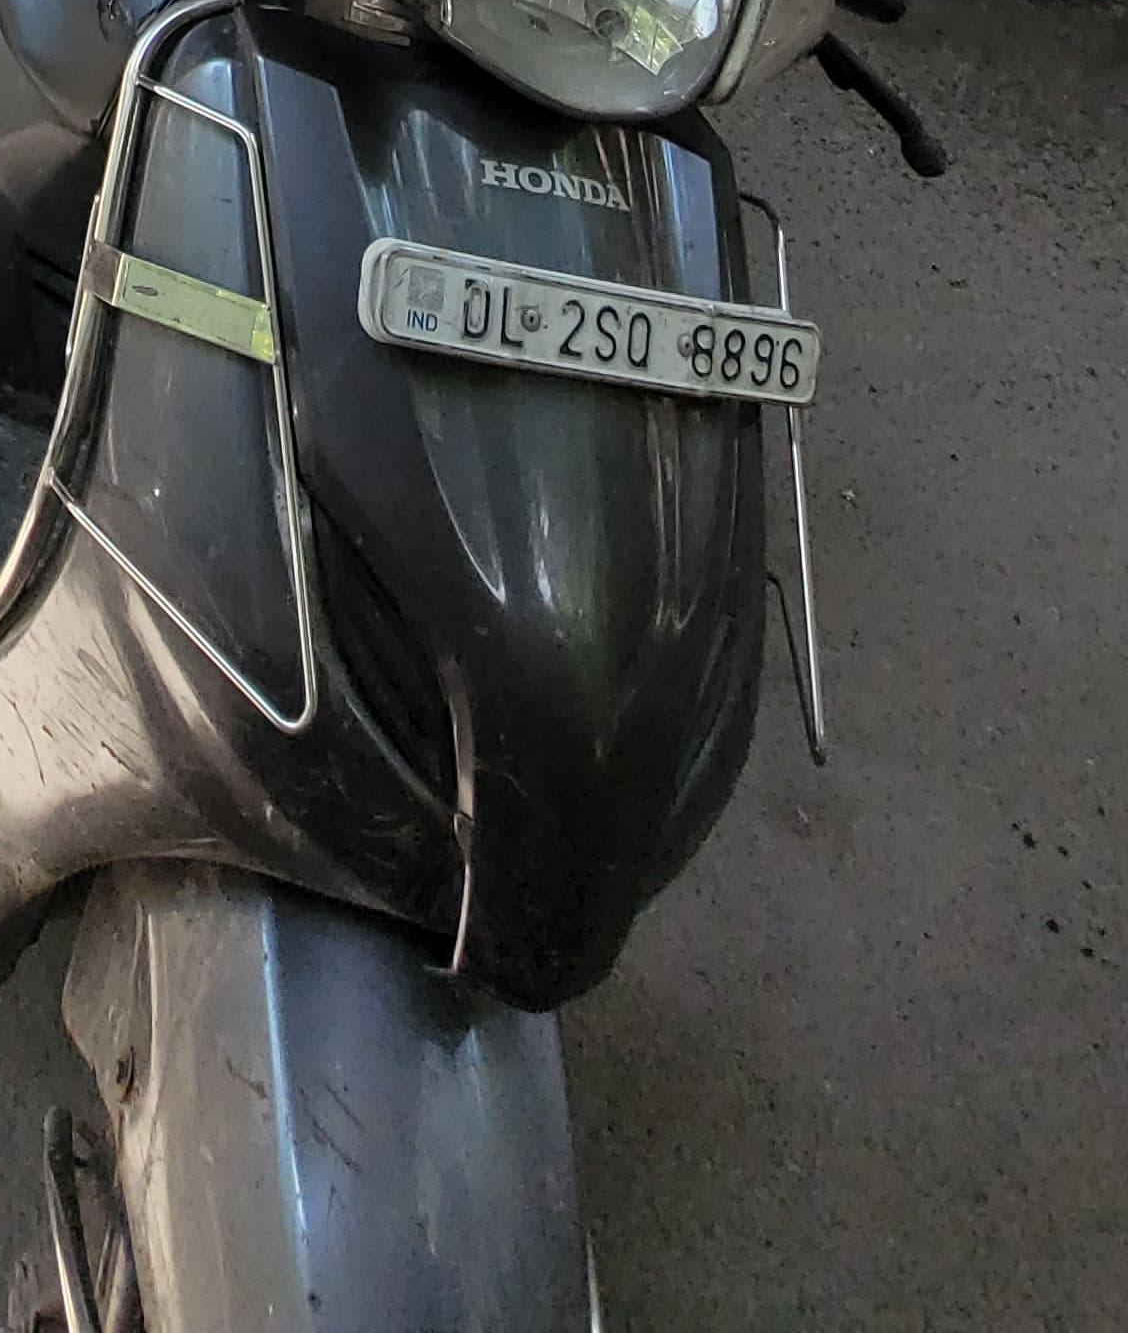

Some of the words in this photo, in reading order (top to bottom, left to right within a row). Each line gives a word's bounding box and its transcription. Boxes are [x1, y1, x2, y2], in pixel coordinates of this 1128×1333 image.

[480, 158, 631, 212] HONDA
[406, 308, 438, 332] IND
[691, 324, 803, 390] 8896
